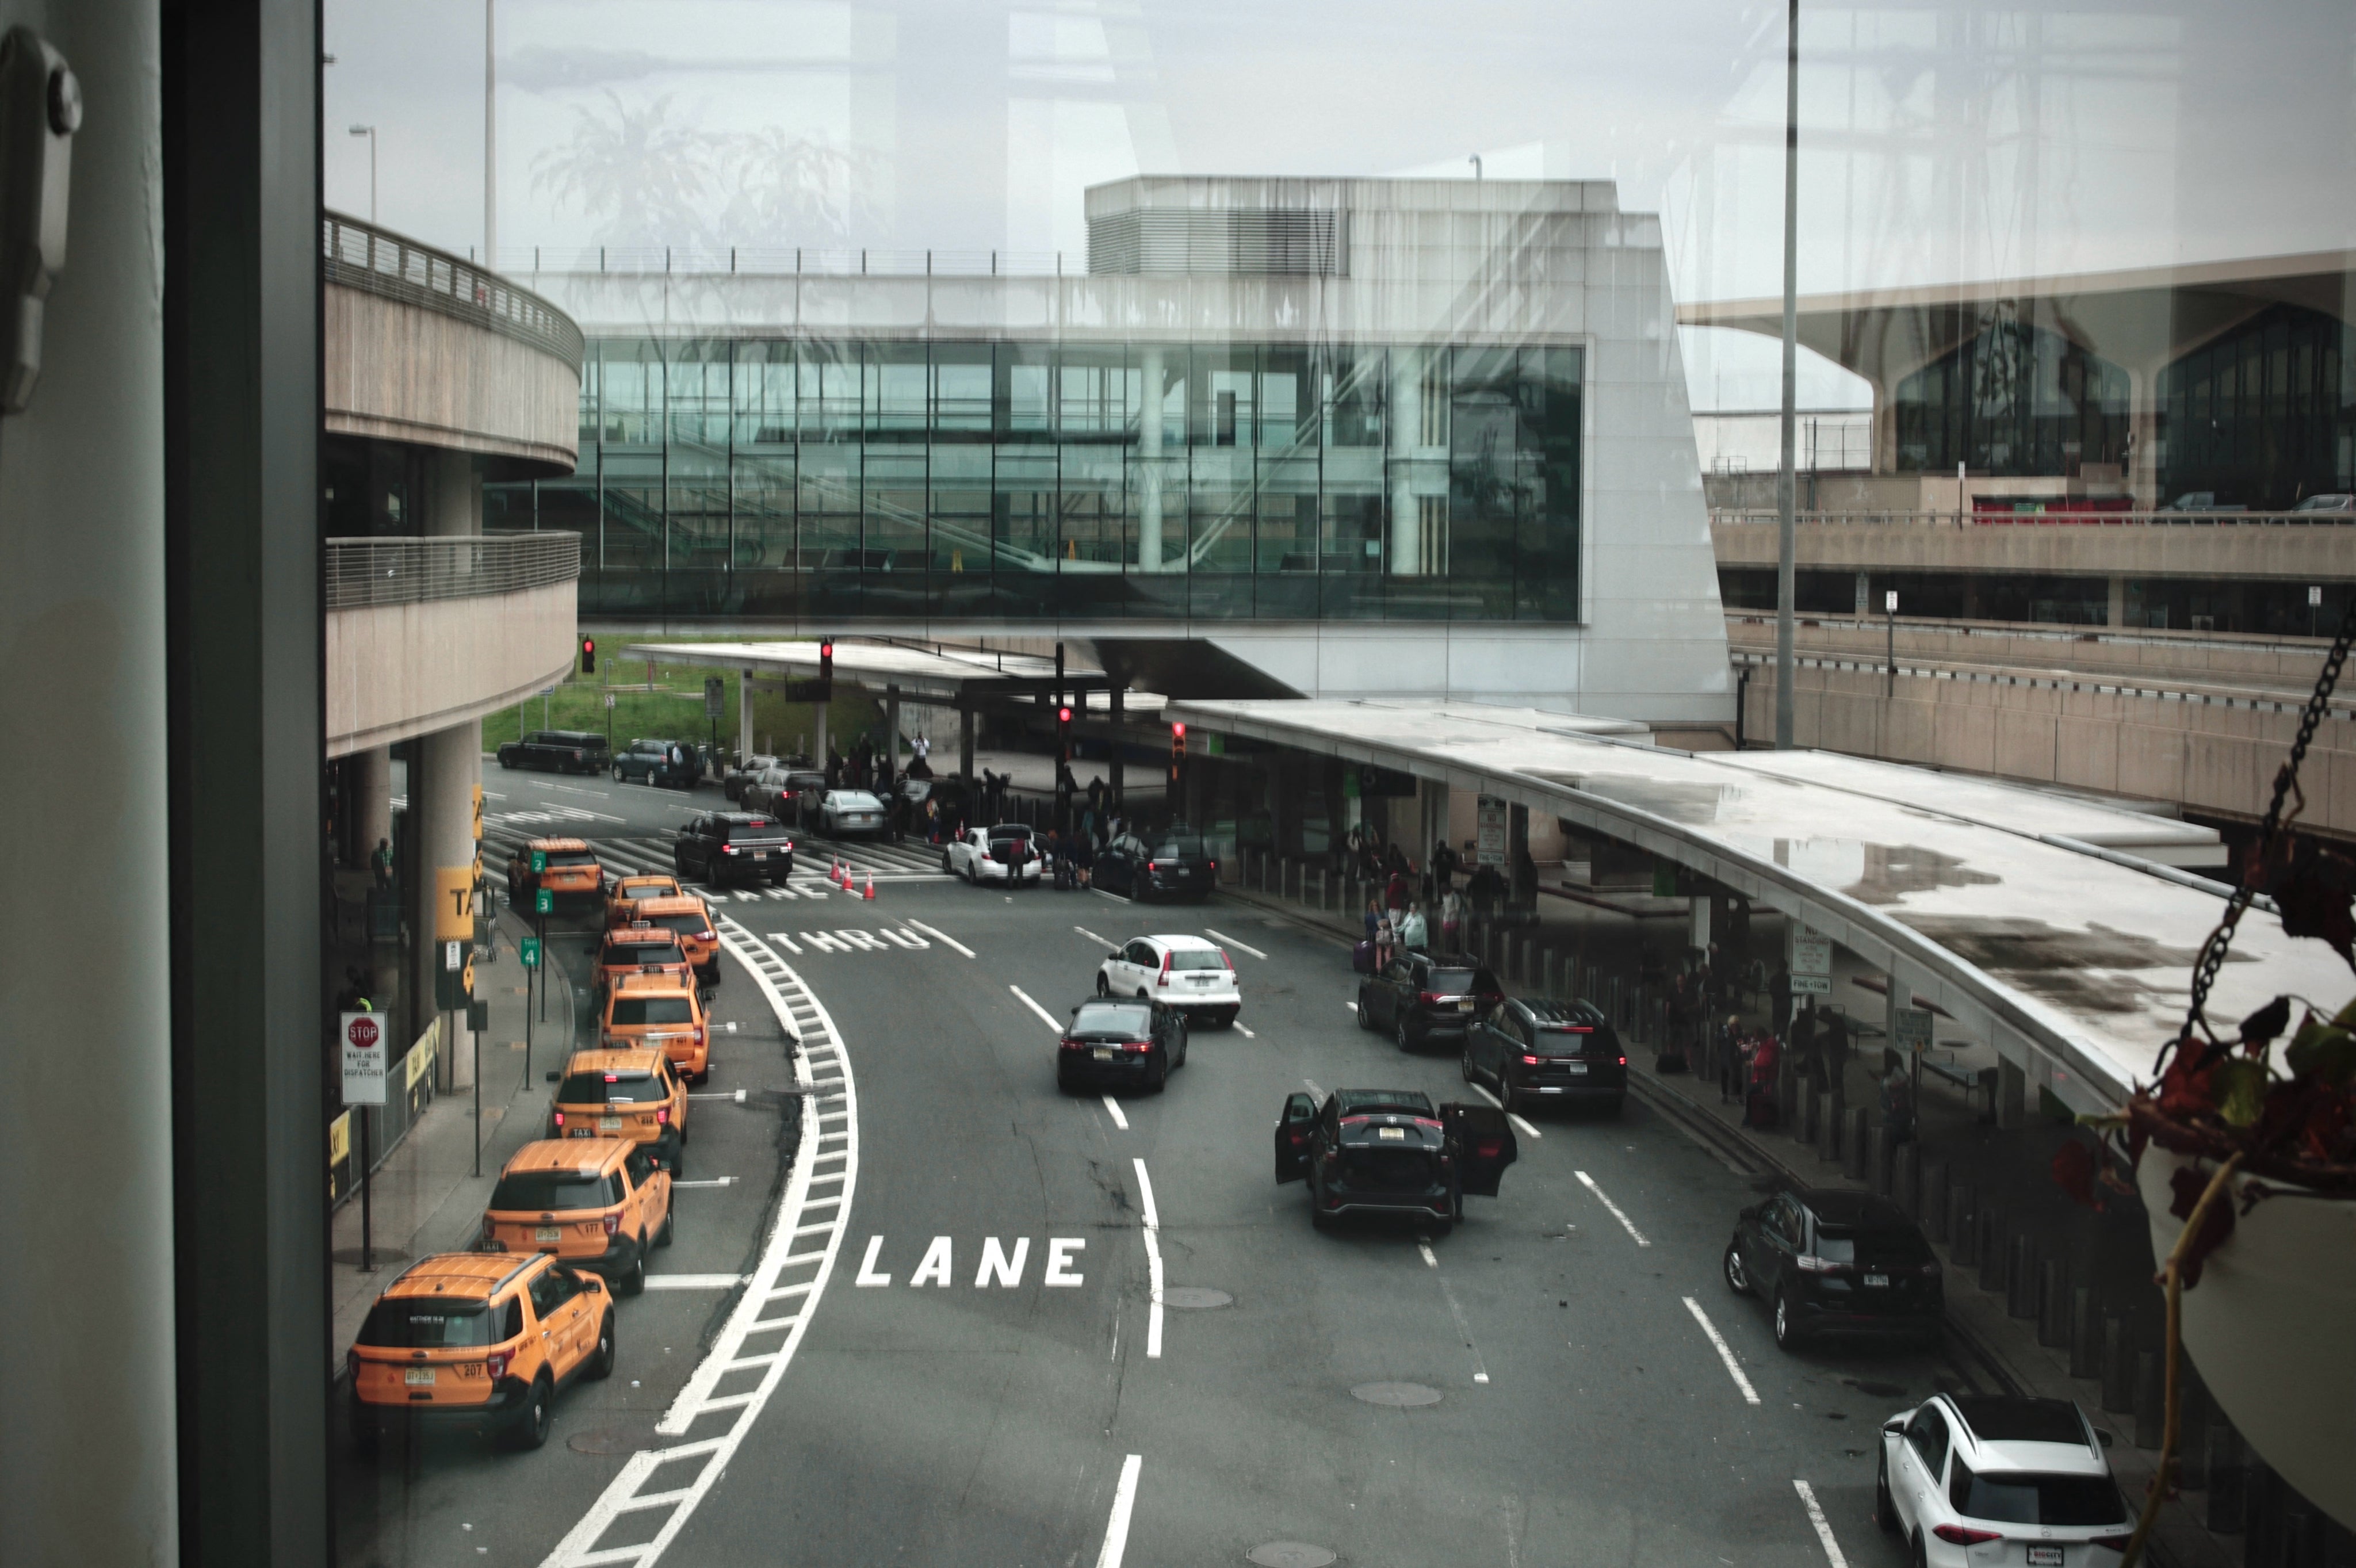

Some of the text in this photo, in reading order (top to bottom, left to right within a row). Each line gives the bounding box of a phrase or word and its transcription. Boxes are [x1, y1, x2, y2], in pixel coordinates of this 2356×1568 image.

[1487, 814, 1496, 822] NO
[534, 860, 541, 870] 2
[541, 898, 548, 909] 3
[767, 929, 930, 954] THRU
[1795, 936, 1829, 944] STANDING
[526, 950, 534, 962] 4
[1793, 980, 1808, 988] FINE
[1814, 981, 1828, 990] TOW
[350, 1027, 377, 1039] STOP
[344, 1069, 384, 1077] DISPATCHER
[573, 1129, 591, 1138] TAXI
[585, 1223, 599, 1233] 177
[855, 1236, 1086, 1288] LANE
[465, 1364, 482, 1376] 207
